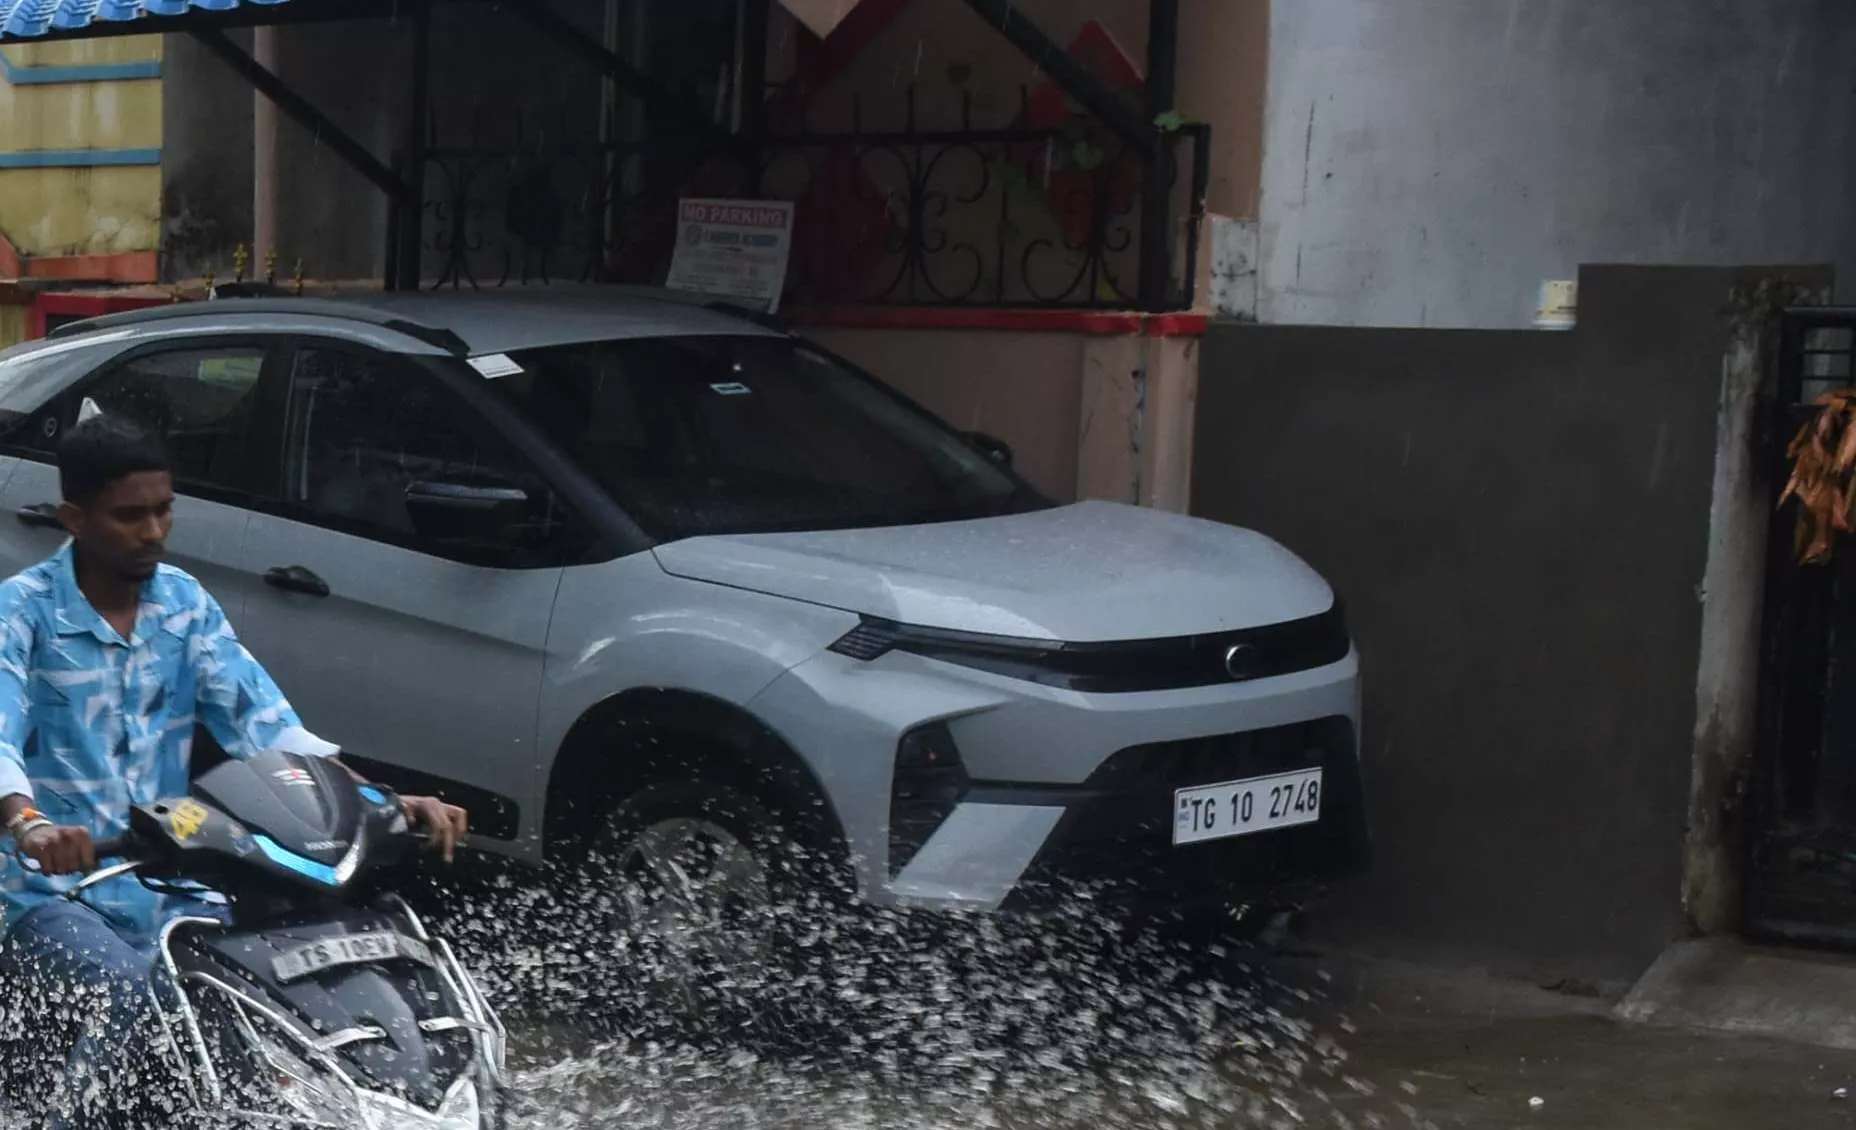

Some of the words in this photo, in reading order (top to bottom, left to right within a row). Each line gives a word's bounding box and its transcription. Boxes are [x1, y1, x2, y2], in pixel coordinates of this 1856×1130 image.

[684, 204, 706, 221] NO
[711, 205, 783, 226] PARKING
[1191, 797, 1216, 832] TG
[1231, 791, 1253, 826] 10
[1269, 778, 1319, 819] 2748
[299, 943, 332, 968] TS
